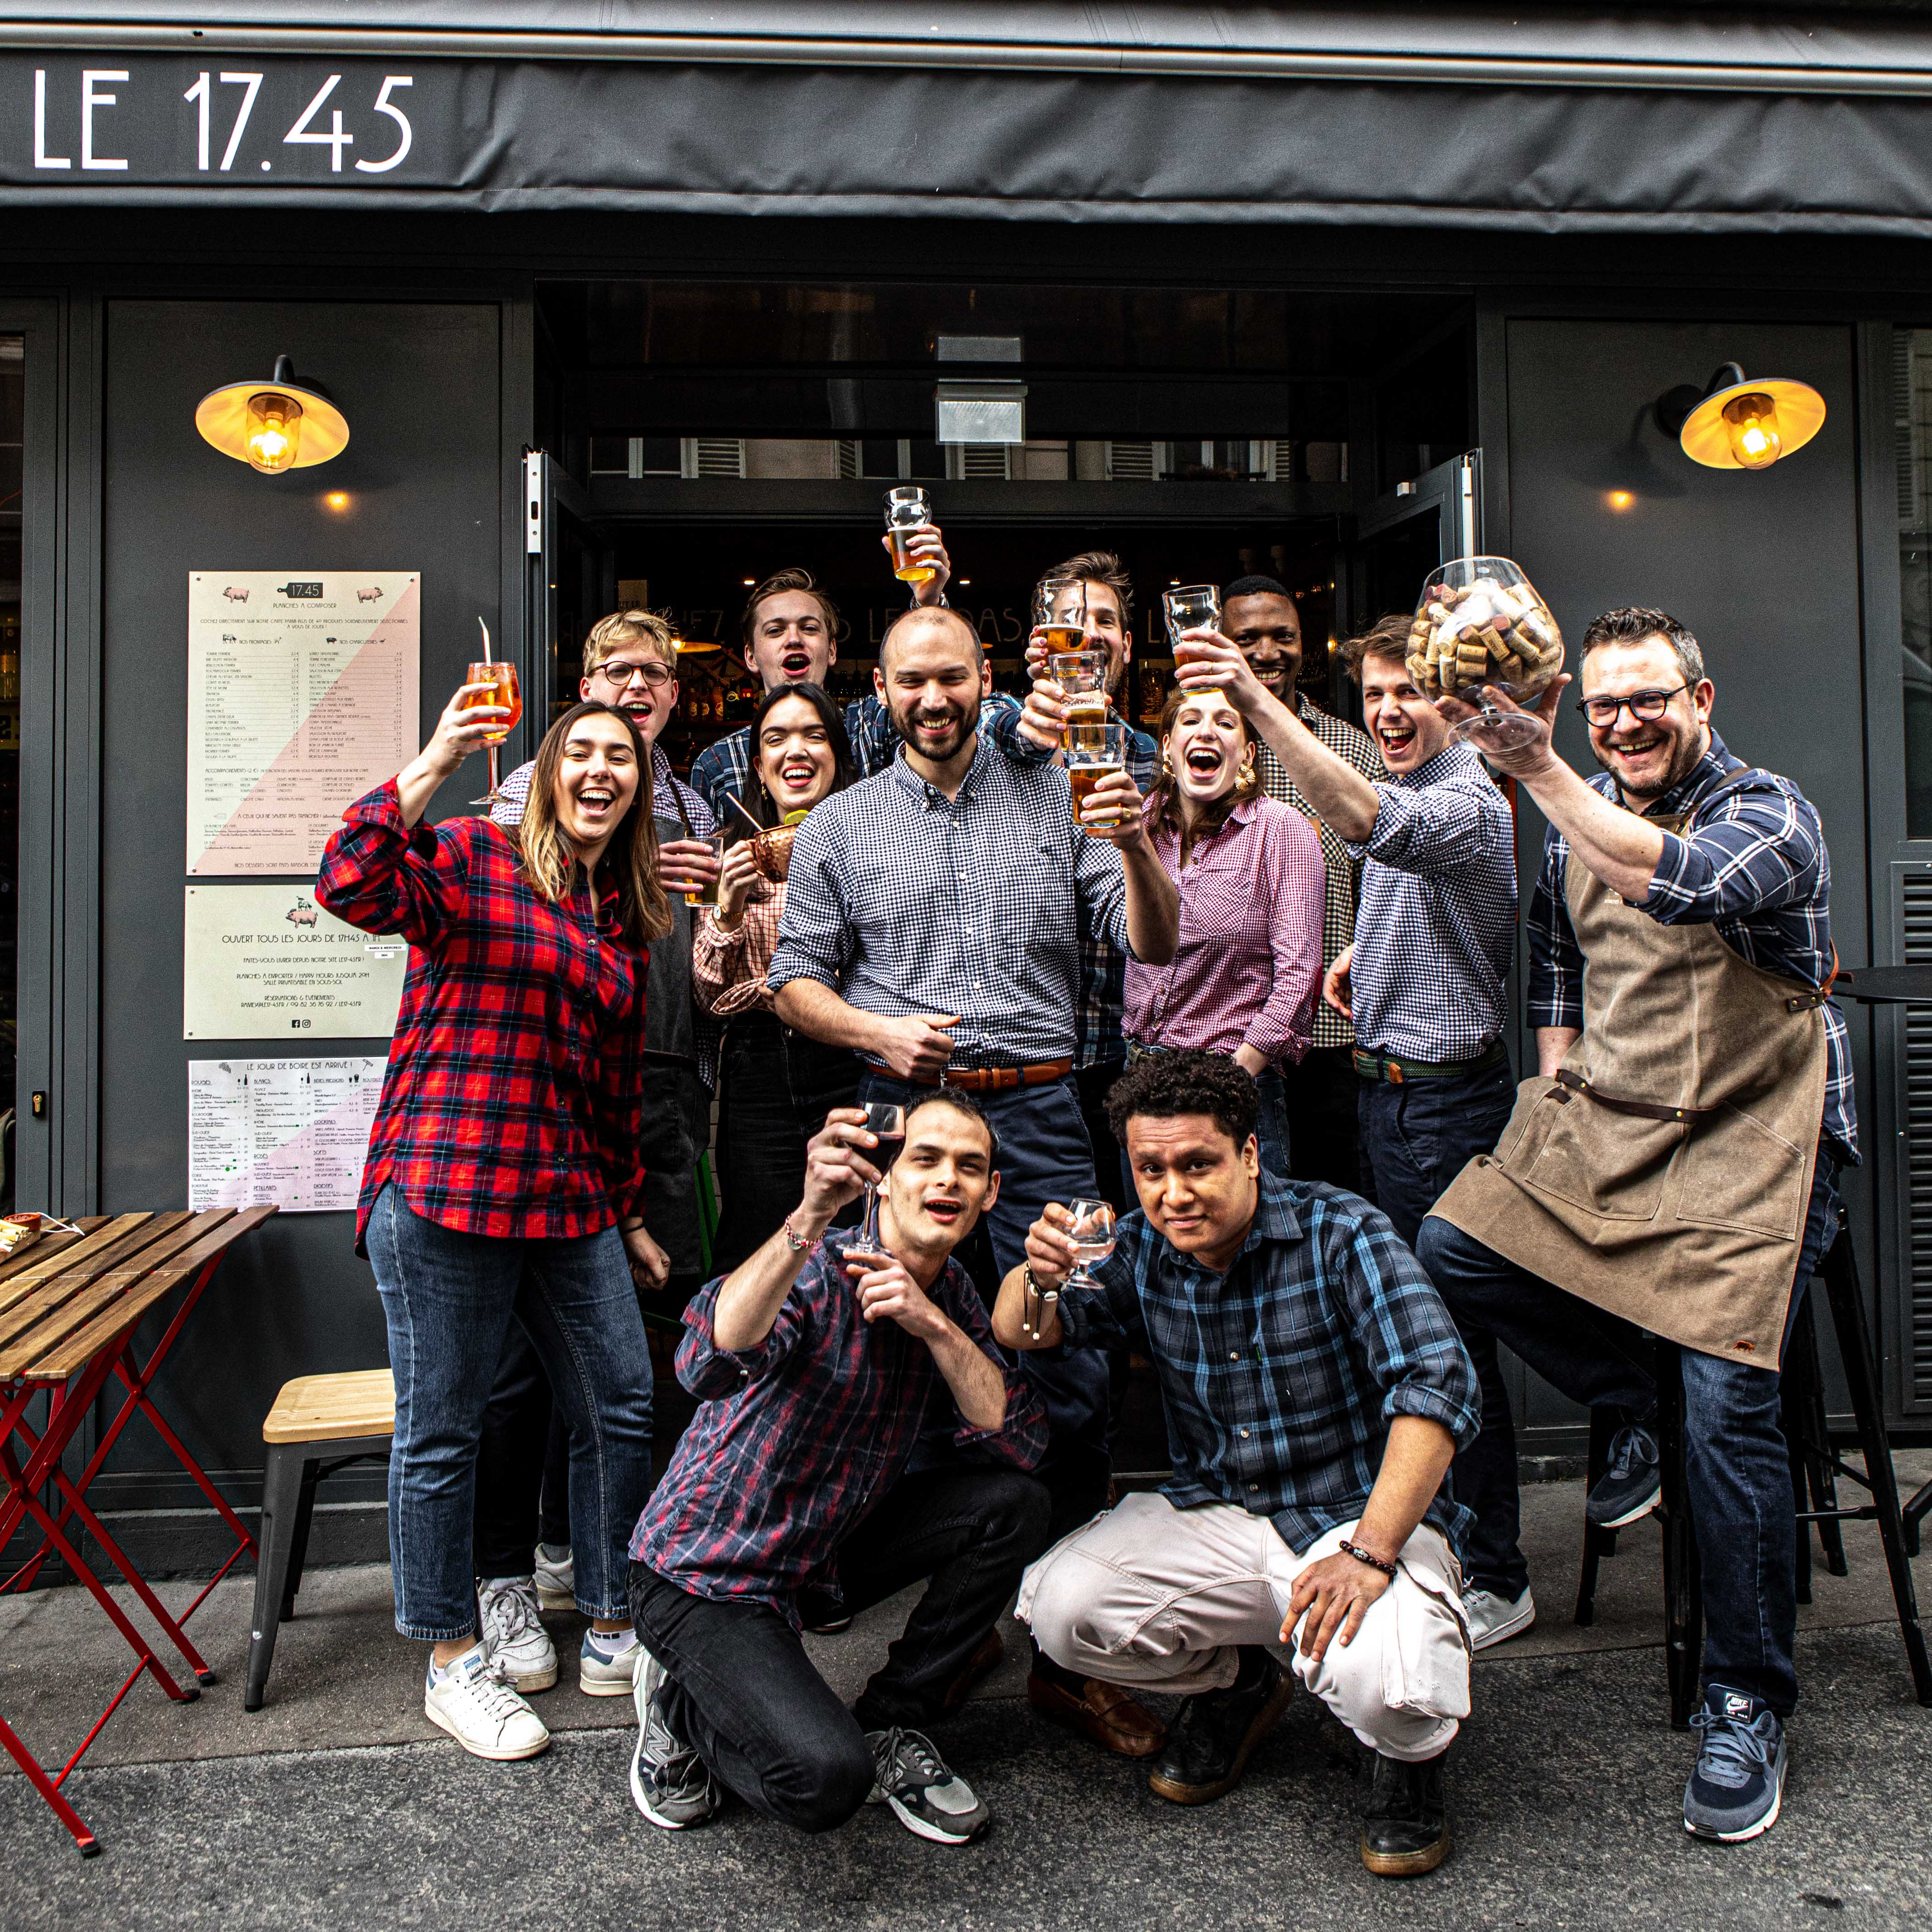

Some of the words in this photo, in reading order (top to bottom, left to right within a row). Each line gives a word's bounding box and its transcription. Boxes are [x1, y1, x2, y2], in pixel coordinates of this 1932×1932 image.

[35, 69, 129, 170] LE
[183, 72, 413, 173] 17.45
[291, 584, 319, 596] 17.45
[222, 935, 253, 943] OUVERT
[257, 935, 279, 943] TOUS
[282, 935, 293, 943] LES
[325, 934, 335, 942] DE
[1730, 1696, 1749, 1709] NIKE
